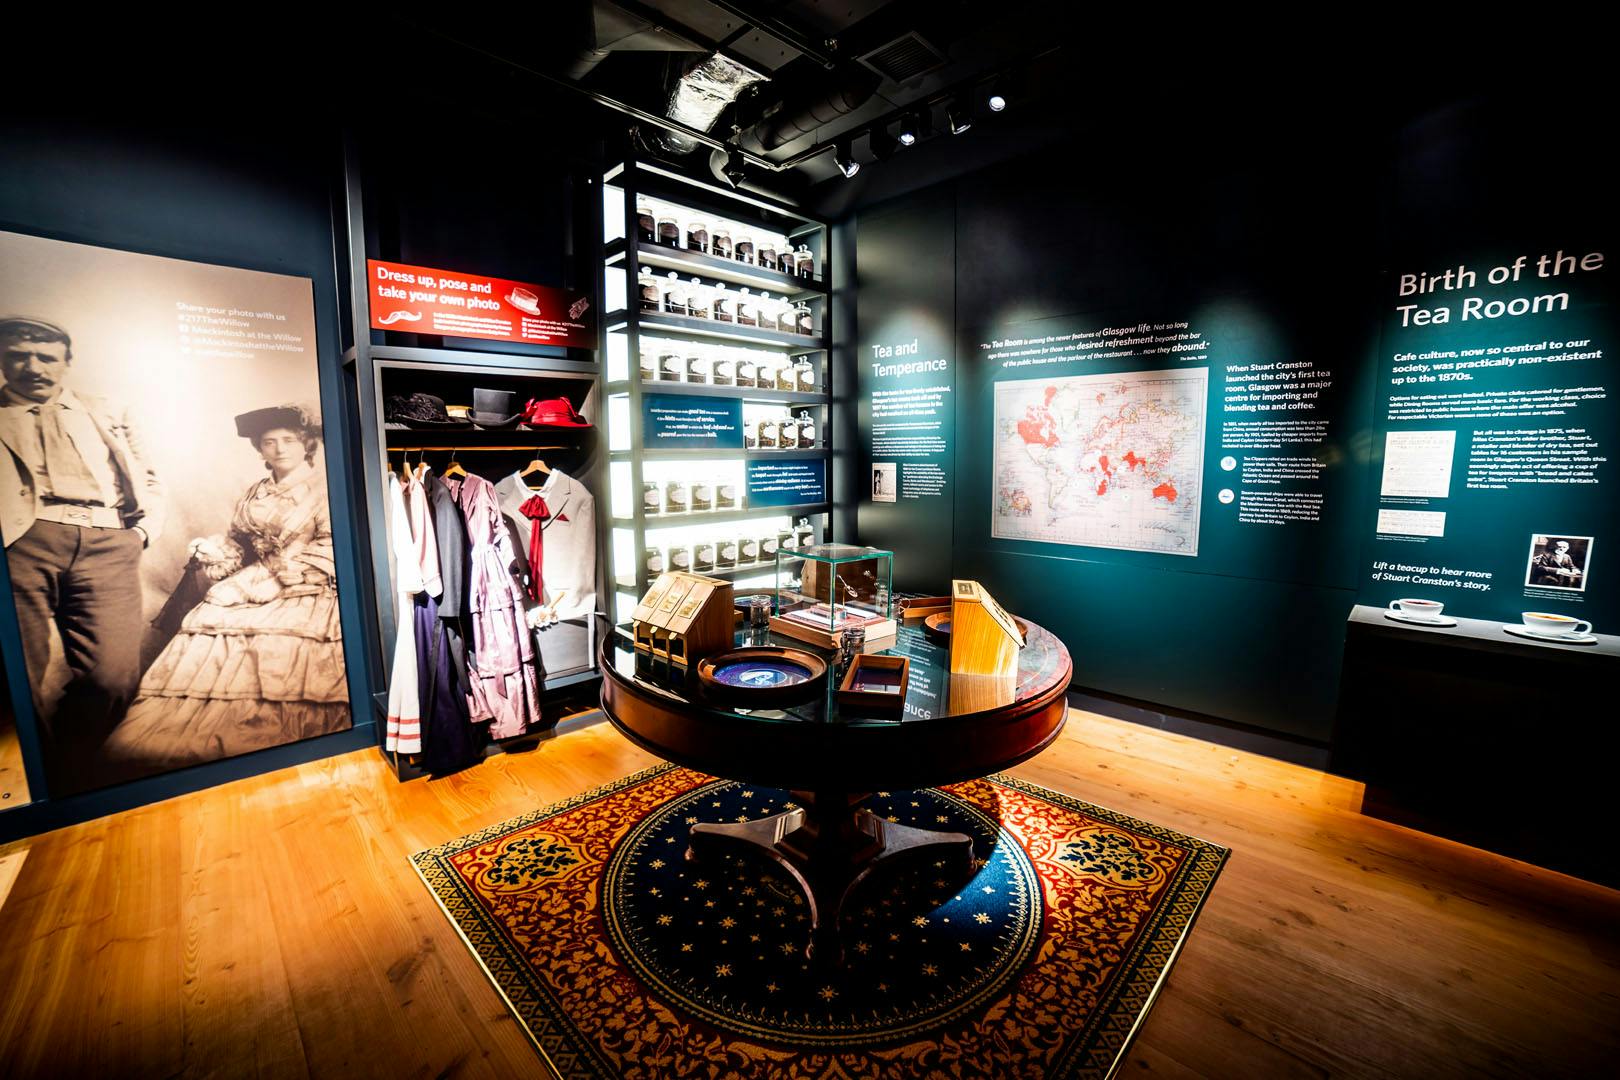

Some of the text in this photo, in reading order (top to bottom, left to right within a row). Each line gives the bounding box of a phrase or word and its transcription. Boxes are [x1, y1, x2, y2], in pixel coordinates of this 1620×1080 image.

[377, 267, 491, 294] Dress up, pose and
[1399, 250, 1604, 297] Birth of the
[378, 285, 500, 310] take your own photo
[1396, 292, 1570, 327] Tea Room
[1102, 326, 1136, 336] Glasgow
[872, 338, 918, 358] Tea and
[1077, 340, 1104, 350] desired
[1105, 336, 1153, 348] refreshment
[1155, 334, 1177, 343] beyond
[1394, 339, 1590, 361] Cafe culture, now so central to our
[872, 359, 947, 378] Temperance
[1250, 362, 1274, 371] Stuart
[1276, 361, 1312, 370] Cranston
[1392, 350, 1602, 373] society, was practically non-existent
[1226, 374, 1259, 383] launched
[1261, 373, 1274, 381] the
[1276, 372, 1296, 381] city's
[1248, 383, 1281, 392] Glasgow
[1307, 380, 1332, 389] major
[1392, 377, 1404, 385] up
[1419, 374, 1436, 382] the
[1438, 372, 1473, 381] 1870s.
[1225, 394, 1248, 402] centre
[1250, 393, 1261, 401] for
[1262, 392, 1300, 401] importing
[1224, 404, 1256, 412] blending
[1271, 402, 1286, 410] and
[1288, 402, 1315, 410] coffee.
[1373, 561, 1388, 571] Lift
[1397, 563, 1428, 575] teacup
[1430, 566, 1440, 575] to
[1441, 567, 1464, 576] hear
[1465, 571, 1492, 579] more
[1372, 572, 1491, 591] of Stuart Cranston's story.
